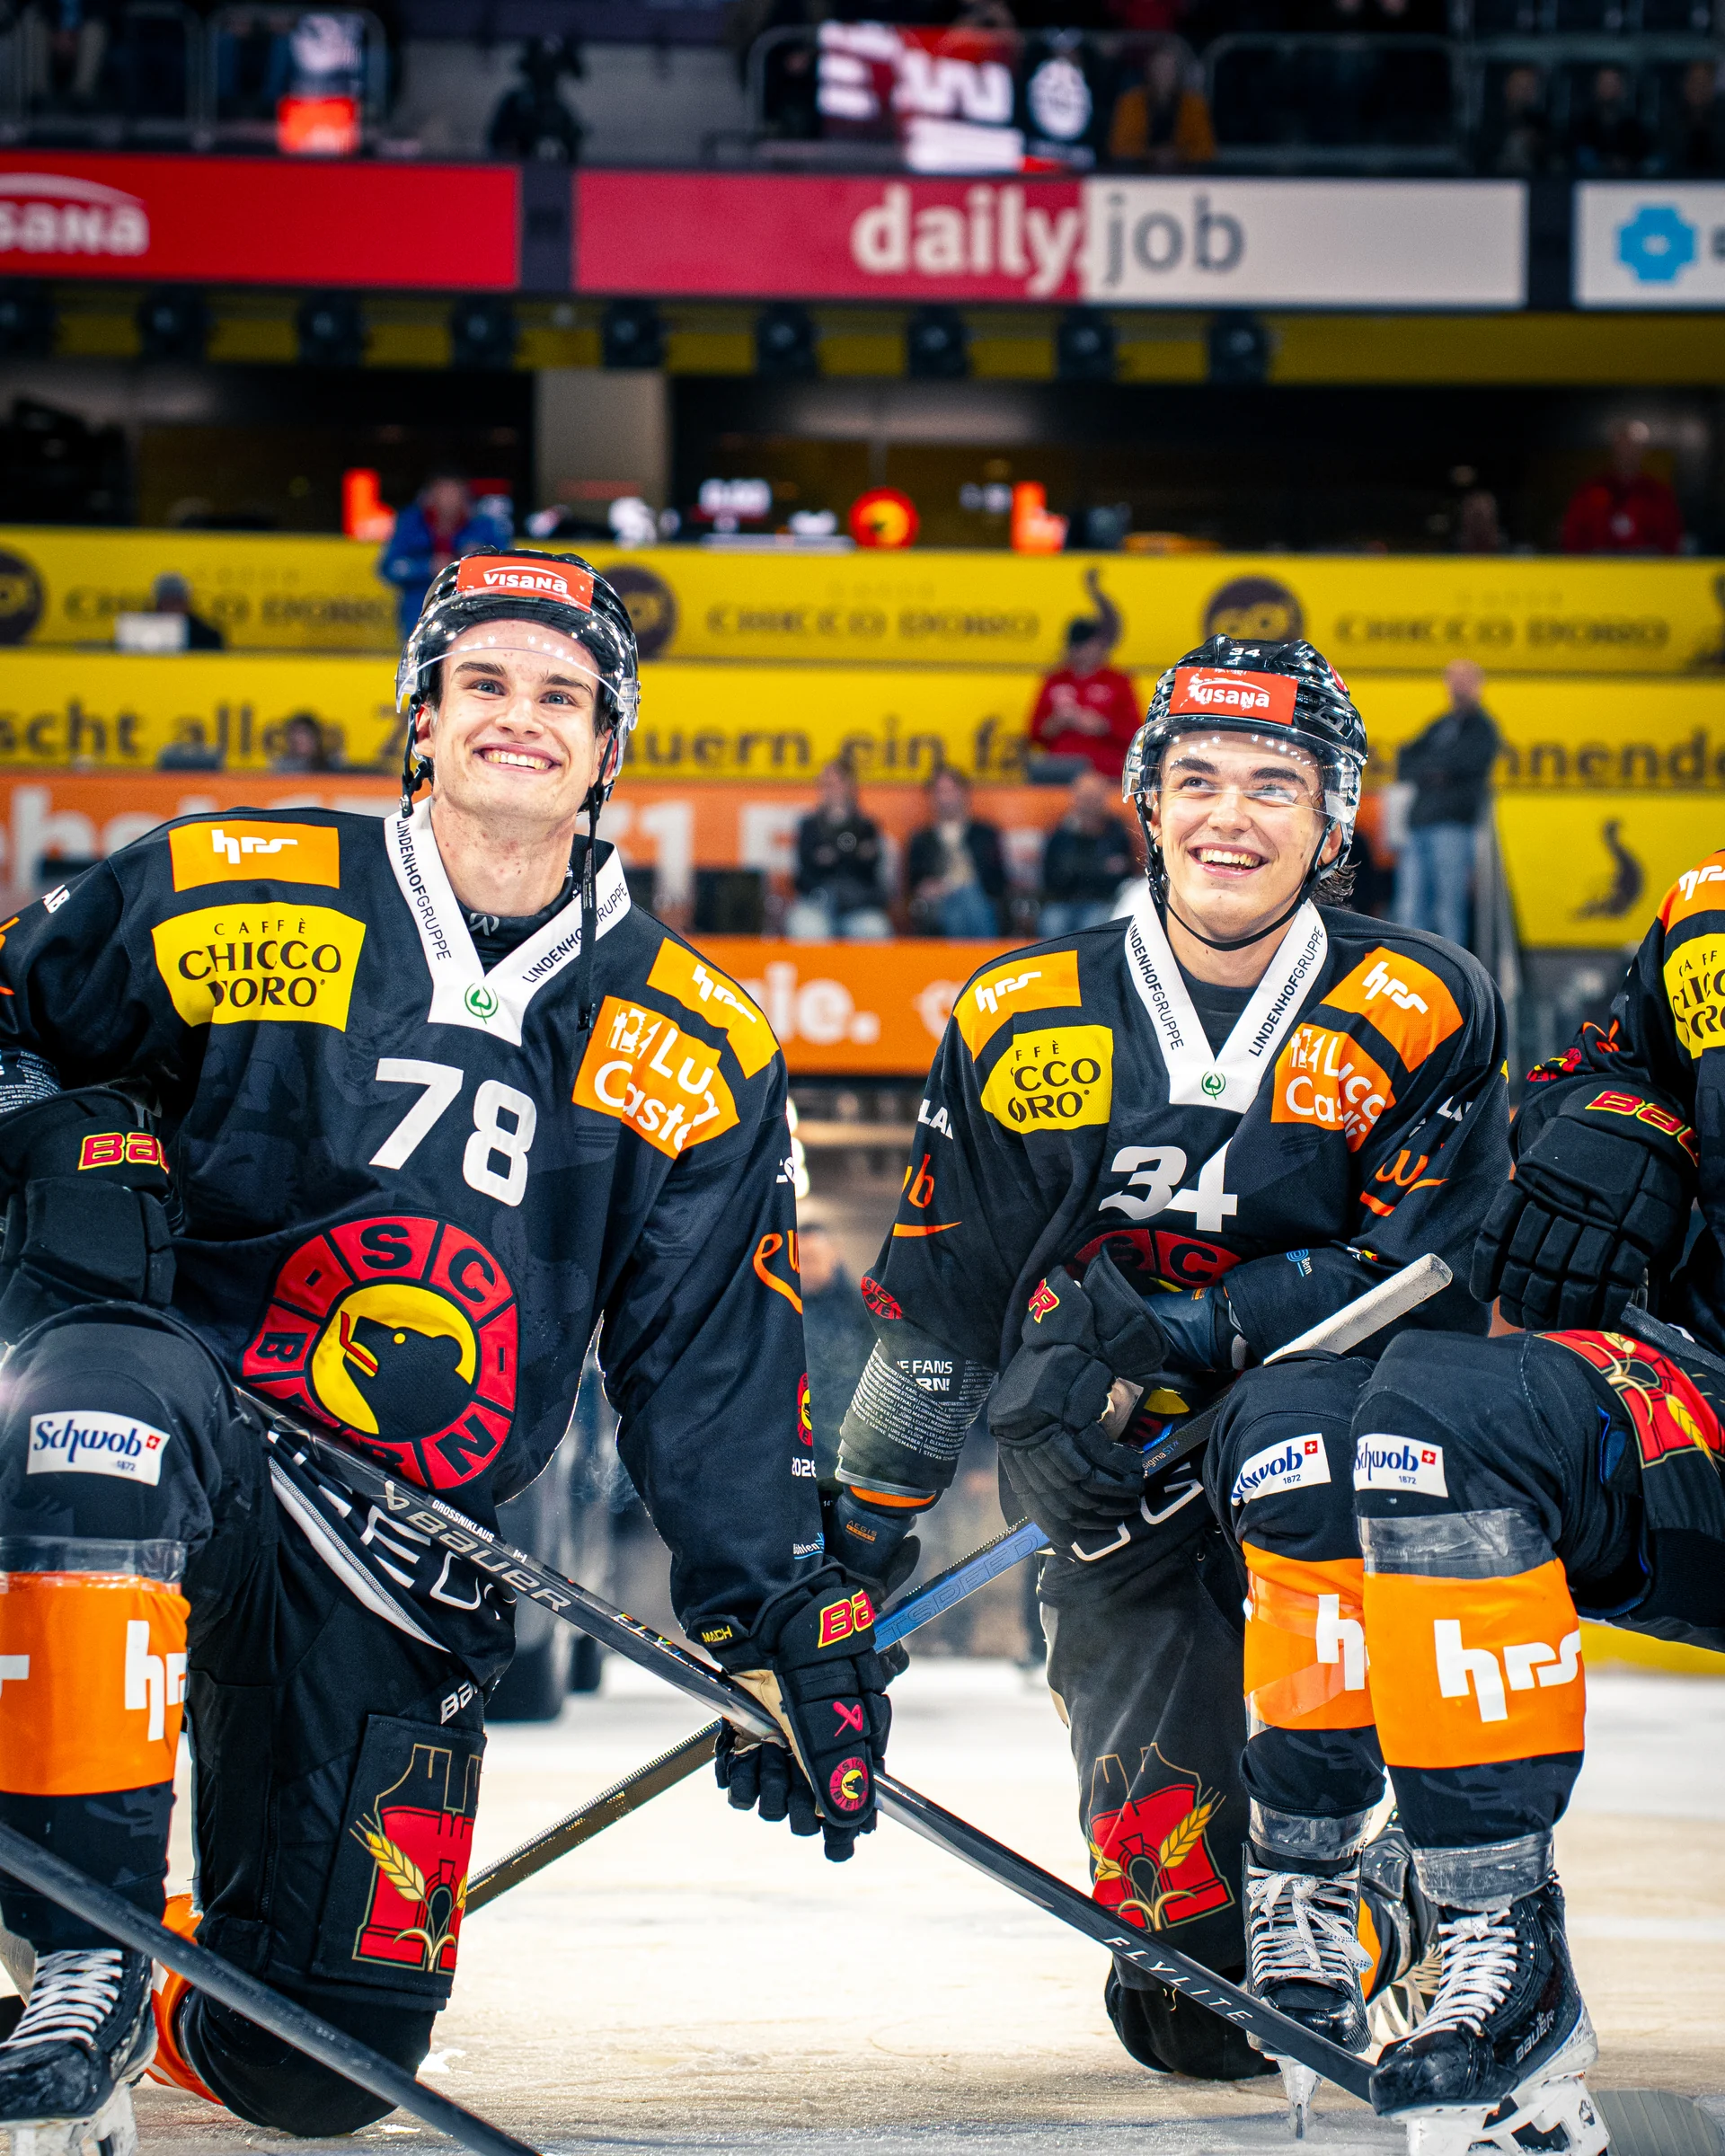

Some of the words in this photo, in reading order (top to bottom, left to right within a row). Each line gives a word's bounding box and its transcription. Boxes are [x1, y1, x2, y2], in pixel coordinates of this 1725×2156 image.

[1229, 647, 1261, 658] 34
[396, 817, 452, 960] LINDENHOFGRUPPE
[214, 917, 306, 936] CAFFÈ
[179, 940, 341, 980] CHICCO
[1248, 927, 1322, 1057] LINDENHOFGRUPPE
[1015, 1039, 1060, 1062] FFÈ
[1011, 1058, 1101, 1091] CCO
[368, 1057, 536, 1207] 78
[1099, 1137, 1238, 1233] 34
[1301, 1257, 1313, 1275] Bern
[912, 1359, 952, 1374] FANS
[33, 1418, 142, 1463] Schwob
[1282, 1473, 1302, 1486] 1872
[1398, 1474, 1418, 1486] 1872
[431, 1499, 495, 1544] GROSSNIKLAUS
[1104, 1936, 1253, 2023] FLYLITE
